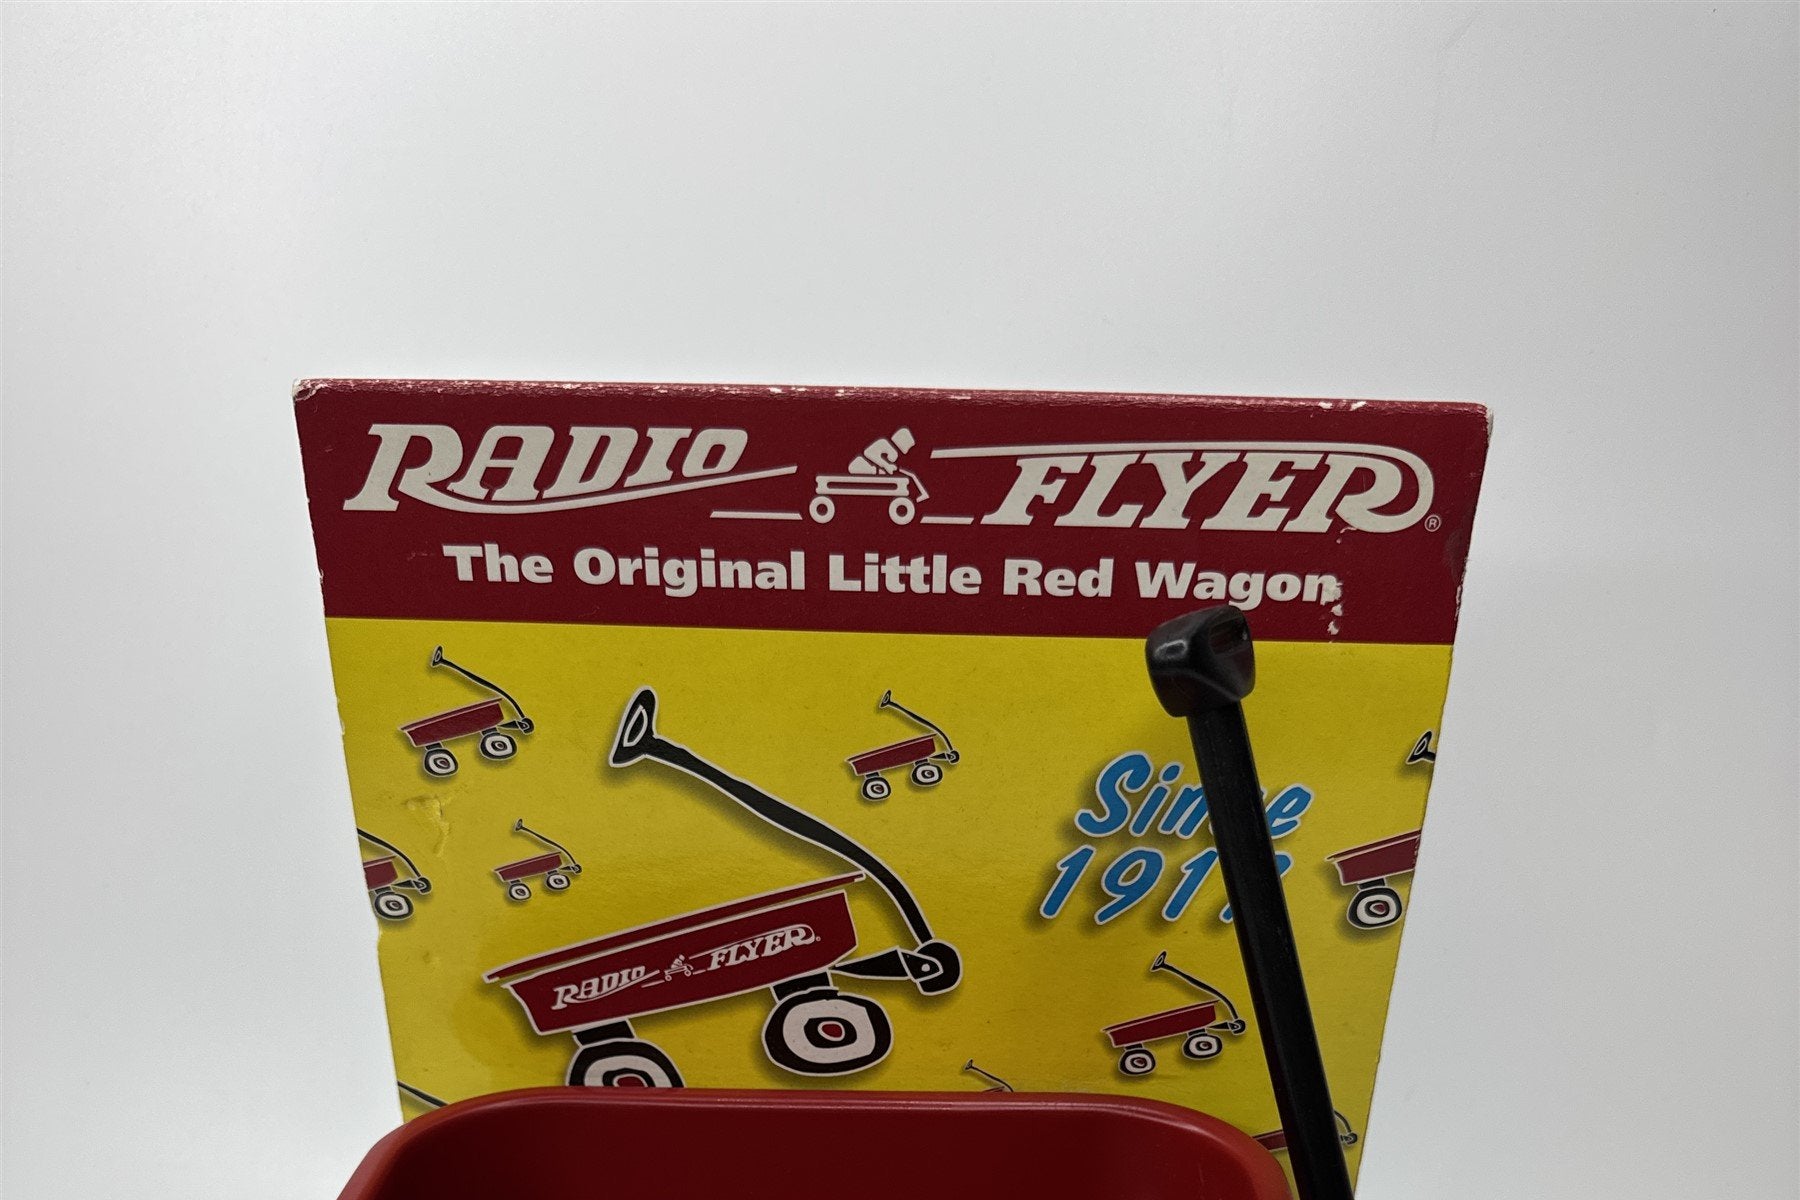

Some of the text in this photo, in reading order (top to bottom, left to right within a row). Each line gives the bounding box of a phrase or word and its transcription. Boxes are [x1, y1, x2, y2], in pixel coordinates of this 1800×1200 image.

[343, 423, 1434, 533] RADIO FLYER
[443, 542, 1344, 611] The Original Little Red Wagon
[1074, 750, 1314, 839] Sine
[551, 923, 816, 1011] RADIO FLYER
